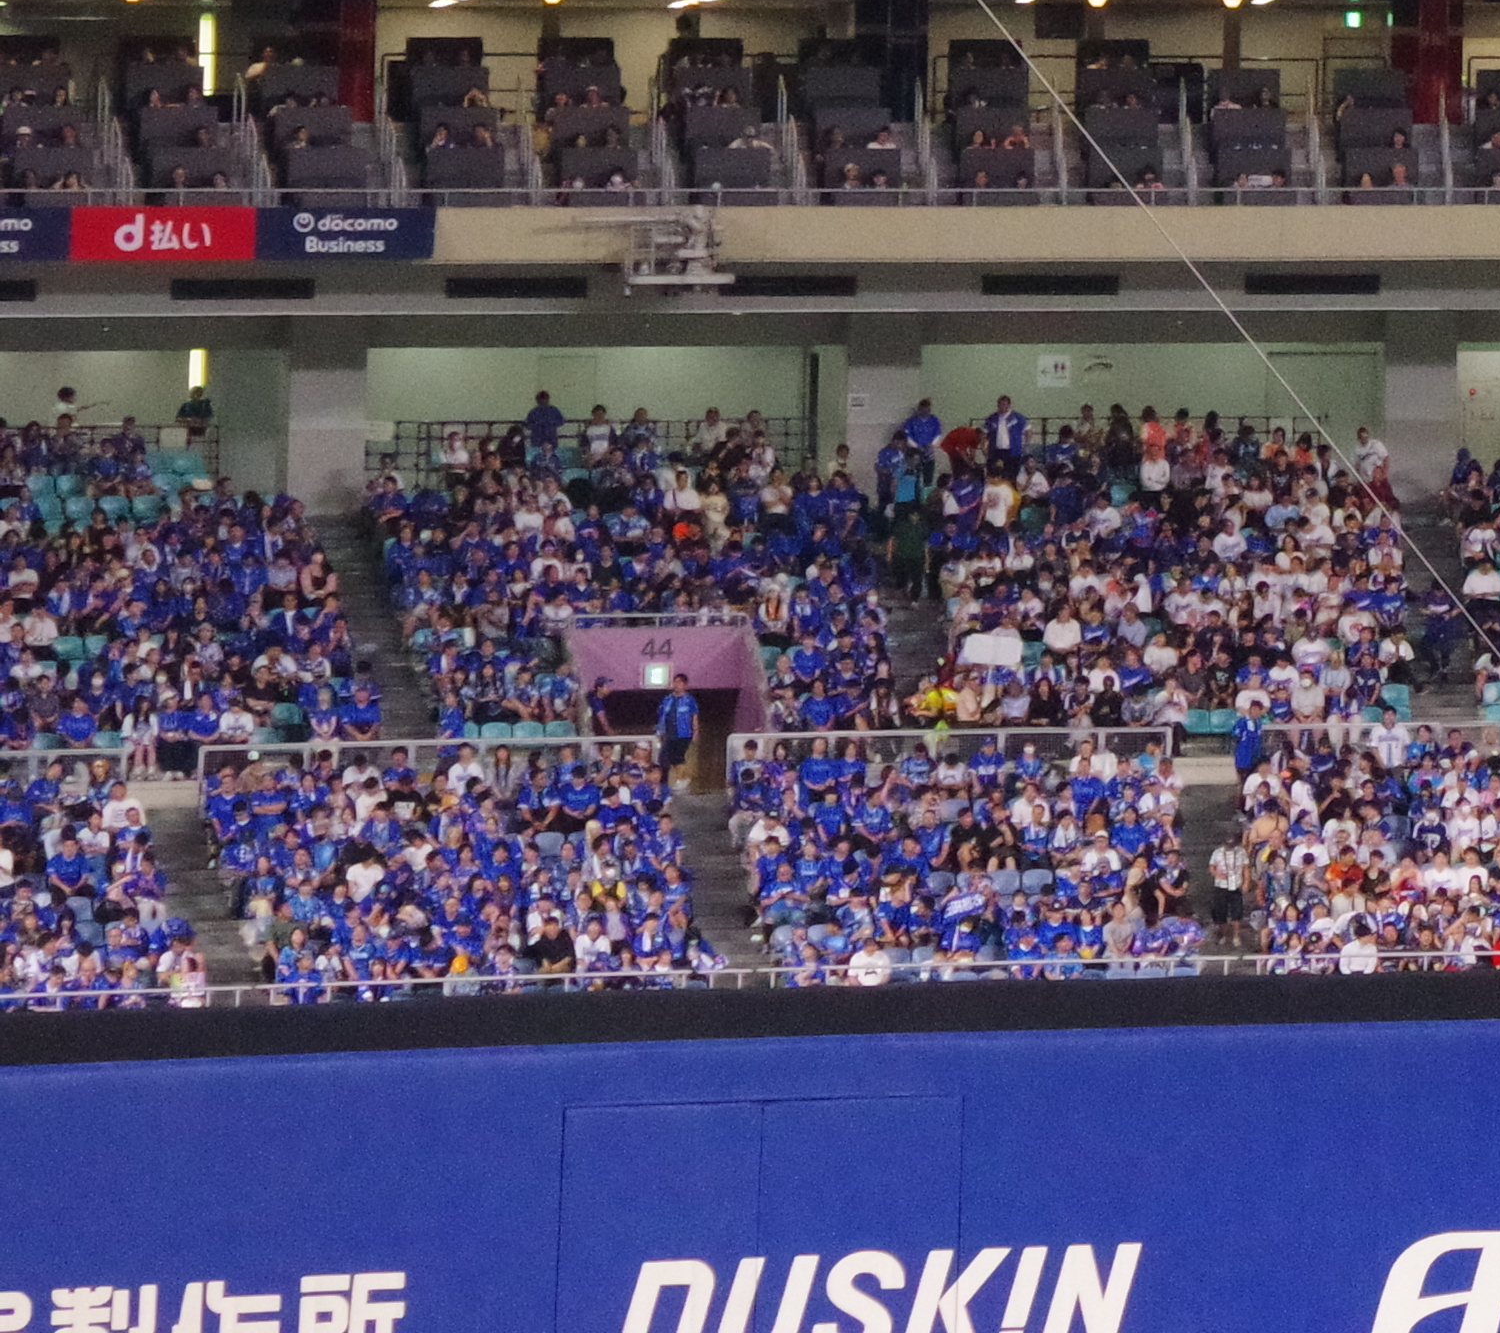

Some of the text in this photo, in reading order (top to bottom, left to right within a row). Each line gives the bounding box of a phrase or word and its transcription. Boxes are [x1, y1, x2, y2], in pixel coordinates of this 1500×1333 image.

[114, 214, 211, 252] d払い
[305, 236, 385, 253] Business
[641, 639, 674, 659] 44
